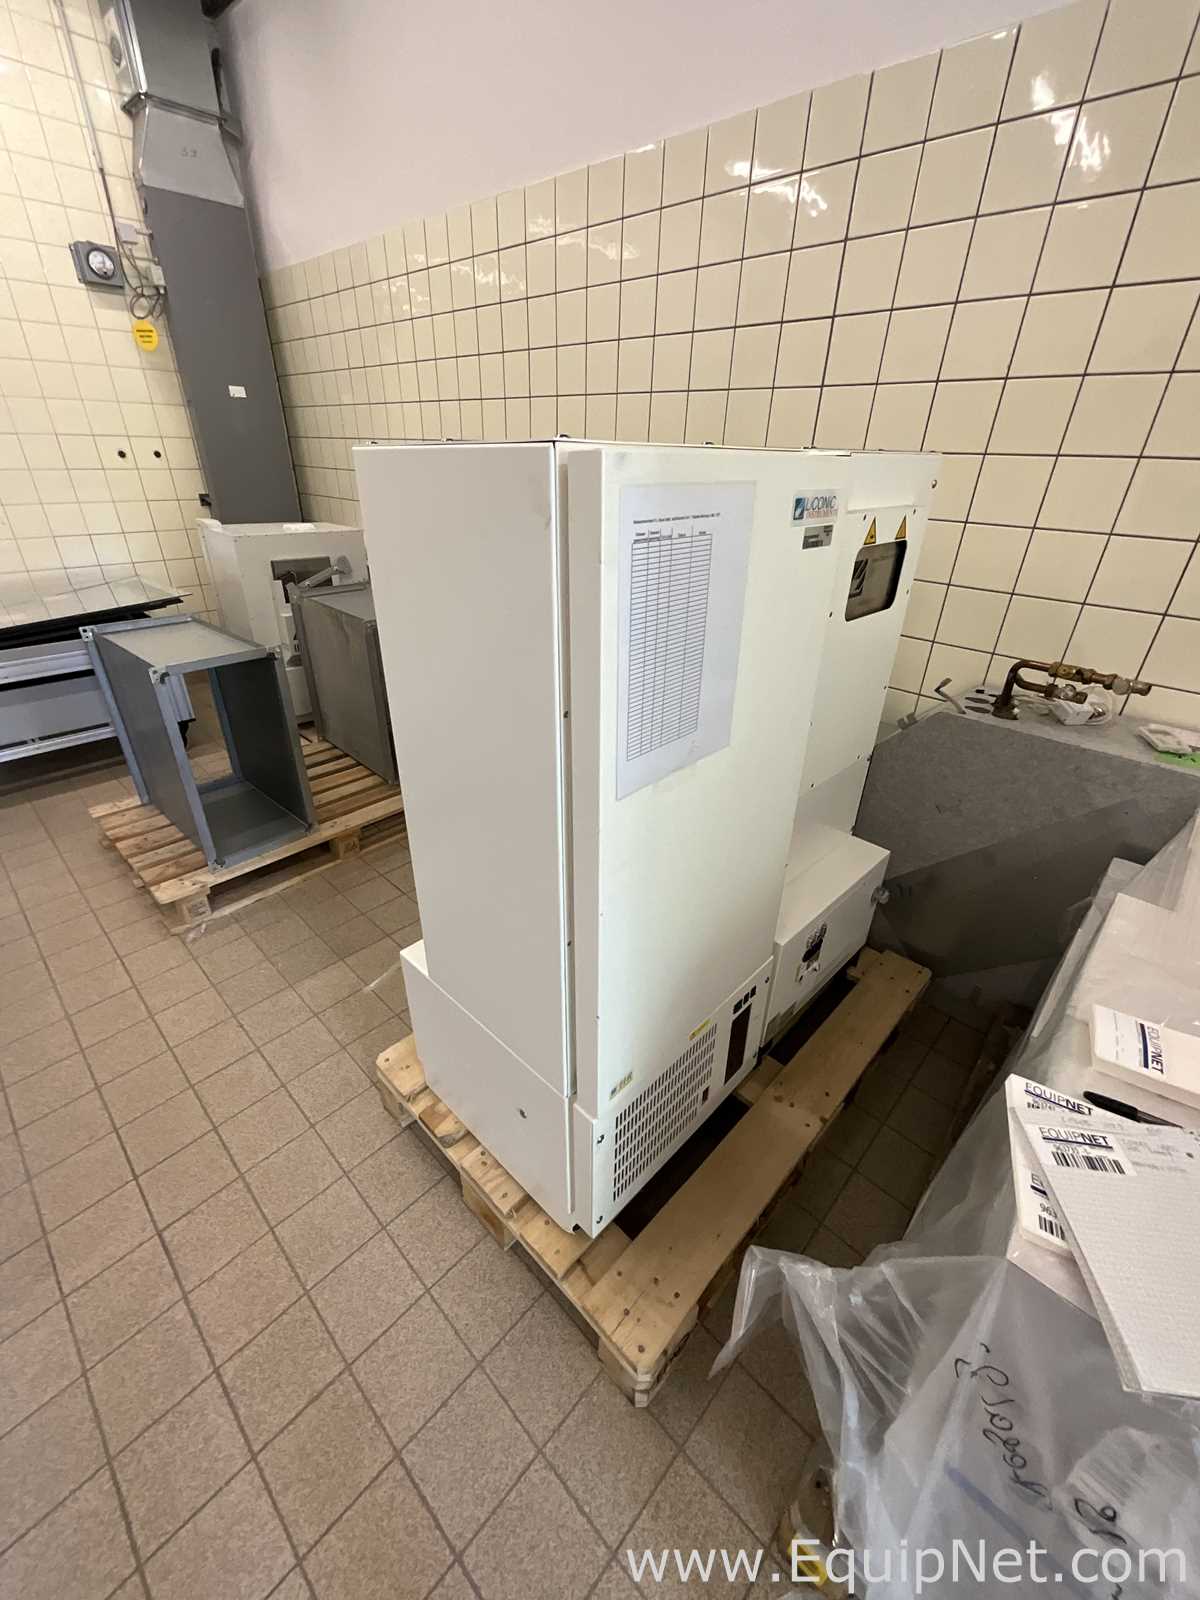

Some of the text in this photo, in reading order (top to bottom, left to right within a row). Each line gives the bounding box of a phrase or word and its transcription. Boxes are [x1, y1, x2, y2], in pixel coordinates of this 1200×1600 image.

[1146, 1025, 1165, 1075] EQUIPNET
[1024, 1081, 1094, 1117] EQUIPNET
[1038, 1126, 1109, 1147] EQUIPNET
